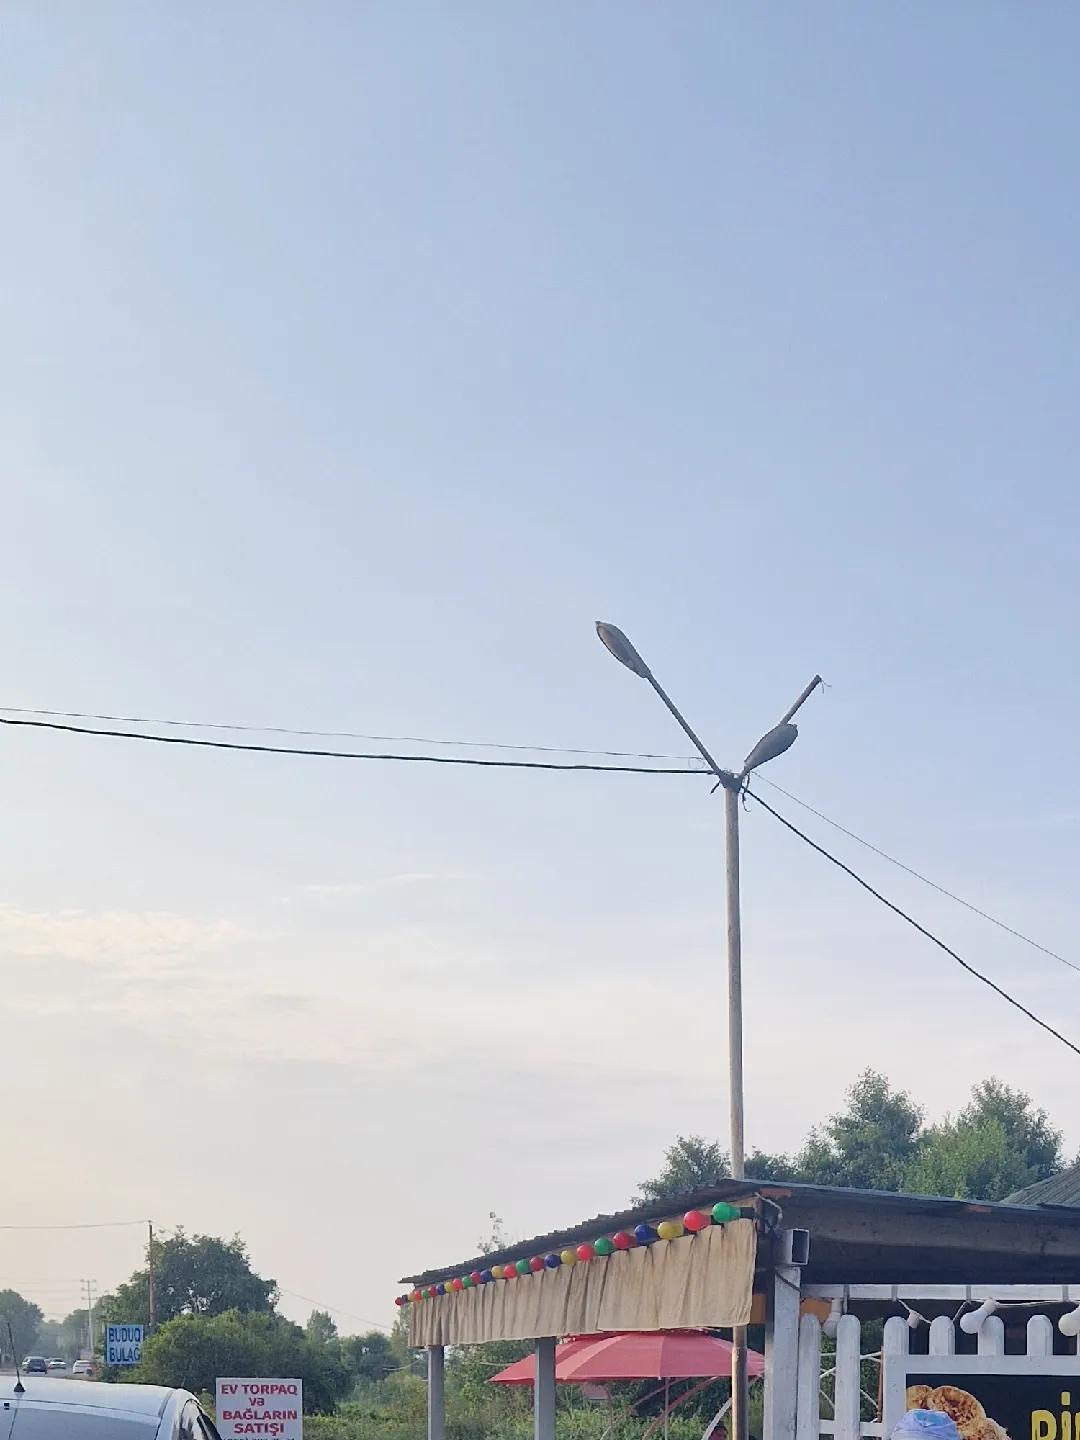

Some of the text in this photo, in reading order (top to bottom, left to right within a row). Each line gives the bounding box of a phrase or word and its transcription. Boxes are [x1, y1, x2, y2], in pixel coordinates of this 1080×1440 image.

[221, 1384, 298, 1396] EV TORPAQ
[222, 1408, 298, 1421] BAĞLARIN
[233, 1422, 285, 1437] SATIŞI
